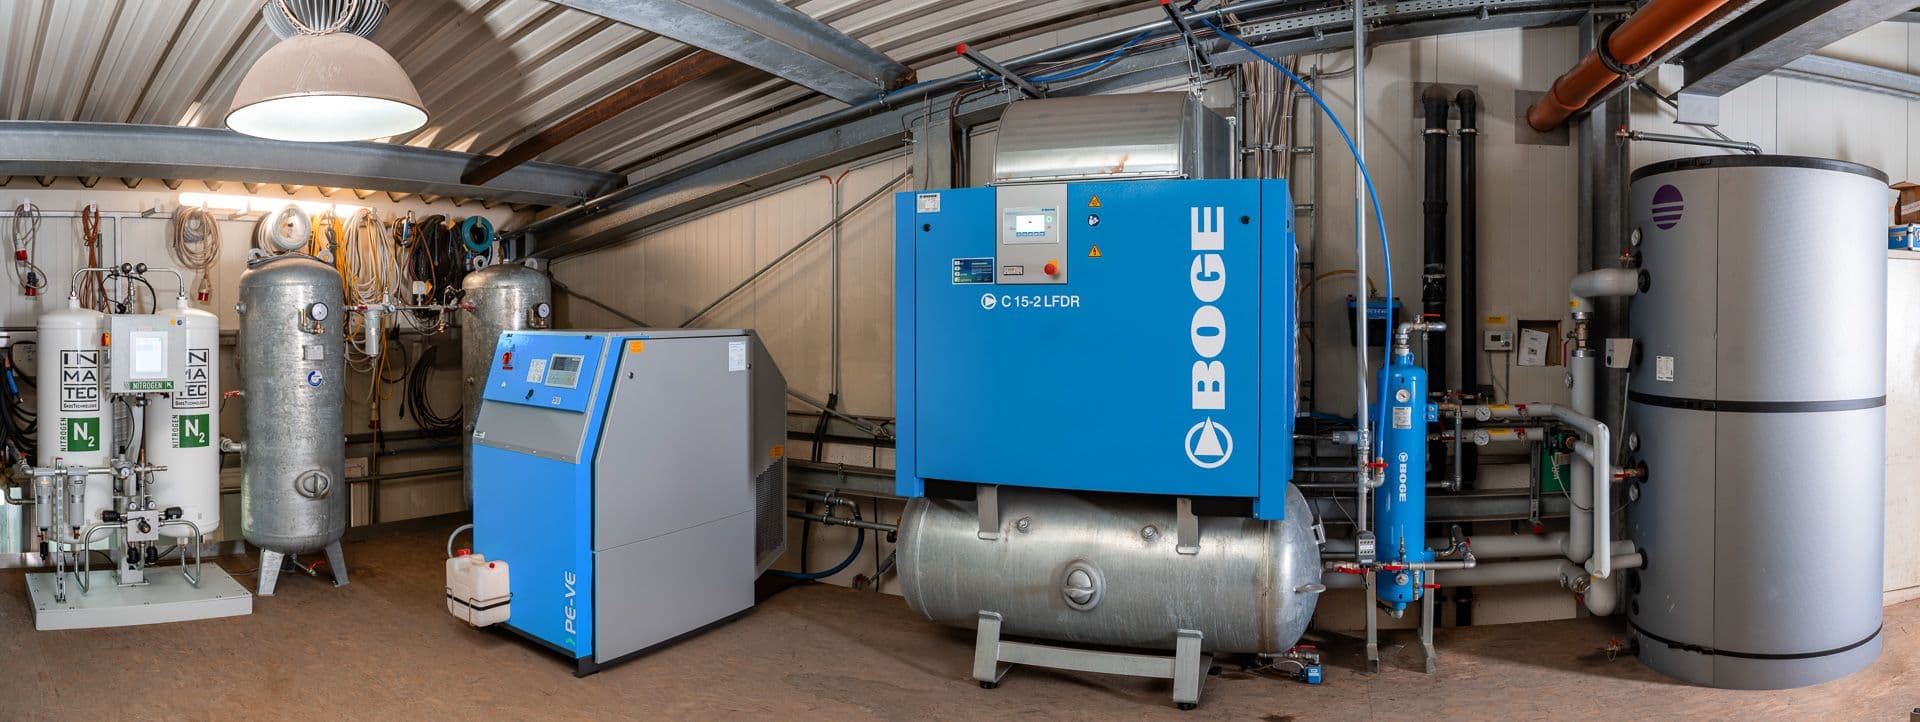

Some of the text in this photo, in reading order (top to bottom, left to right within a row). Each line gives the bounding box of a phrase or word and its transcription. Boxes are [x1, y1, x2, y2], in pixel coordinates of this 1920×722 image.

[1001, 295, 1080, 308] C 15-2 LFDR
[1190, 206, 1226, 410] BOGE
[63, 353, 97, 365] IN
[188, 351, 207, 363] N
[63, 370, 97, 382] MA
[131, 382, 163, 390] NITROGEN
[63, 387, 97, 399] TEC
[1398, 463, 1407, 503] BOGE
[564, 570, 577, 635] PE-VE
